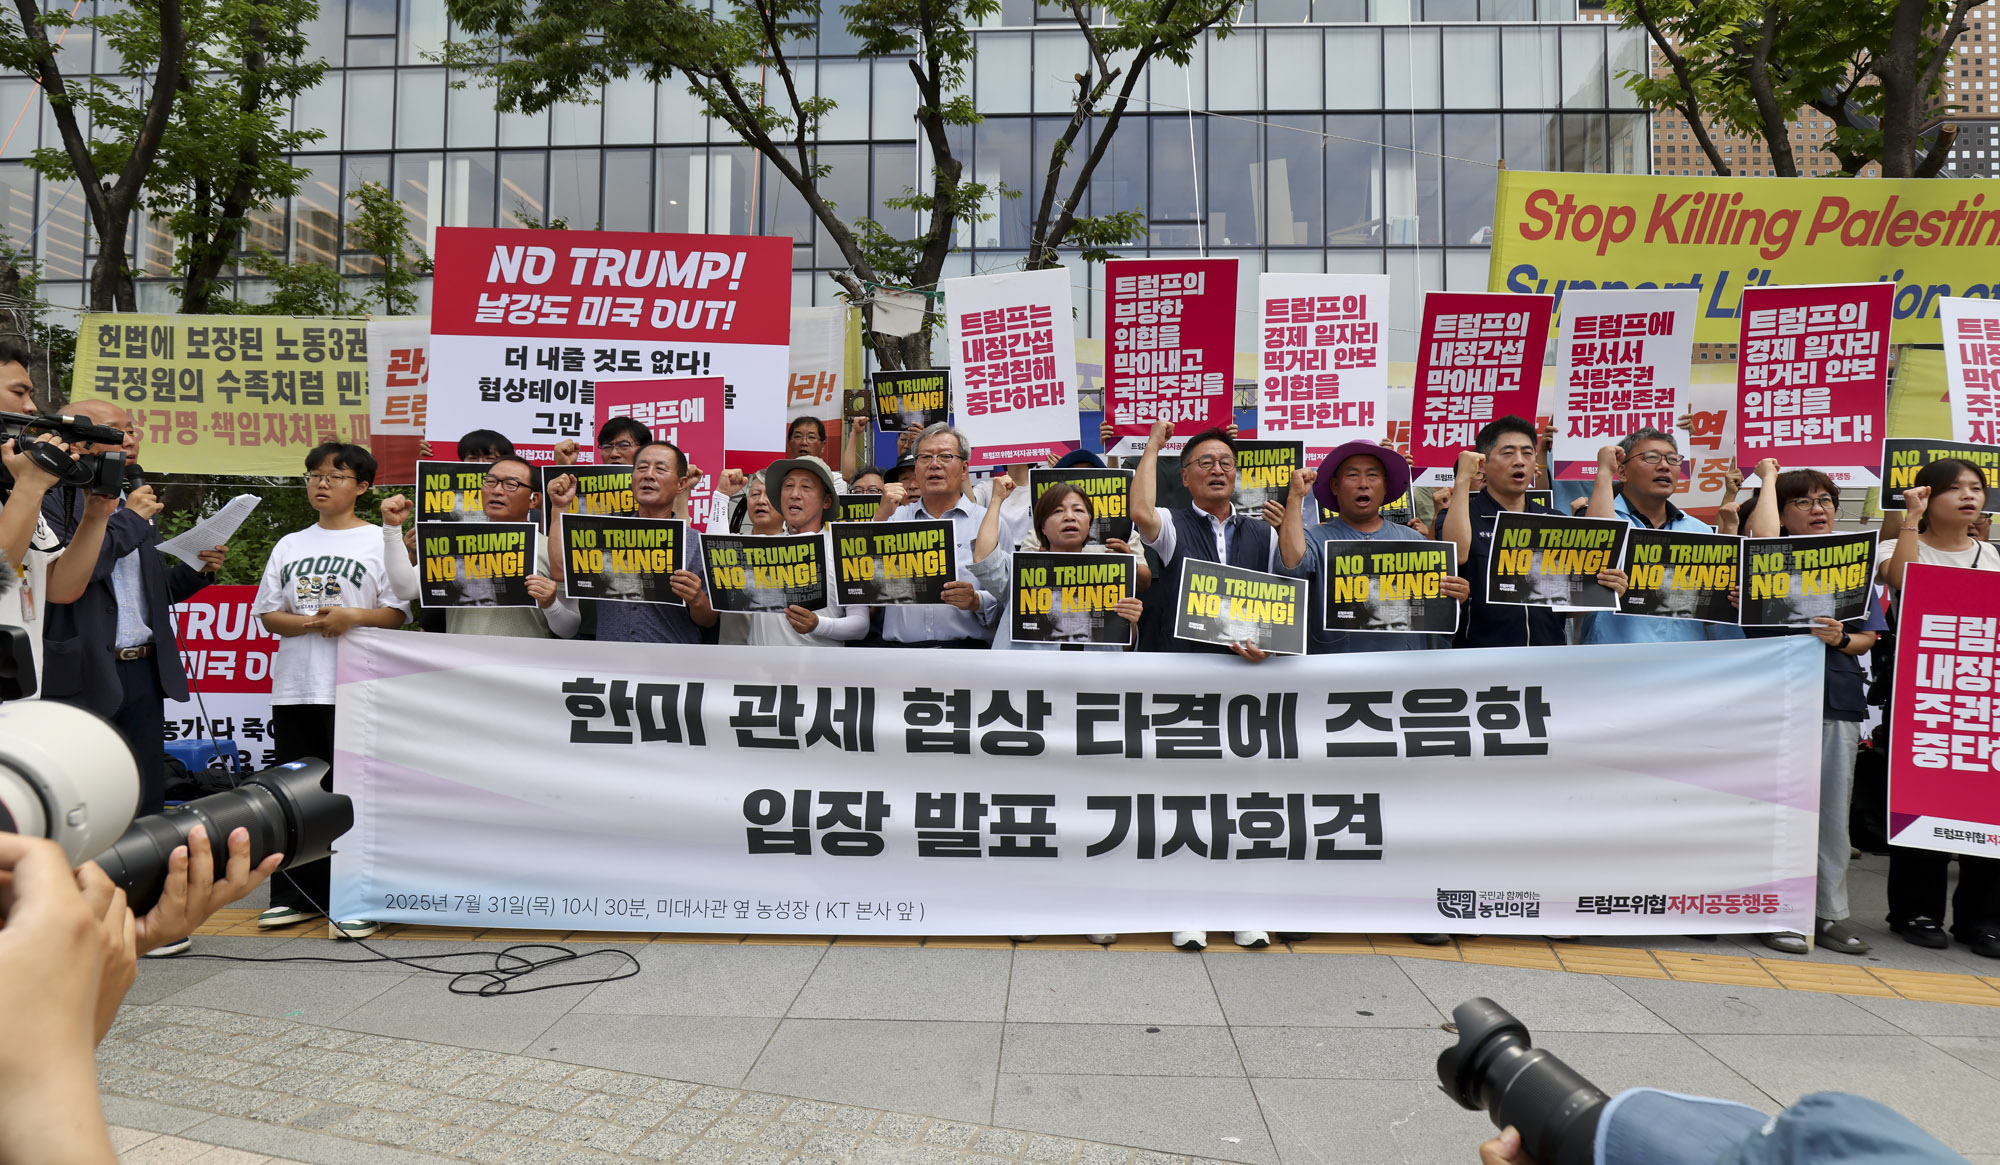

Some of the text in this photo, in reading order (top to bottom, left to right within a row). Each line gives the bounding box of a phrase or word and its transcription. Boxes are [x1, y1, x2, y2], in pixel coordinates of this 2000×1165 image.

[1519, 188, 1637, 256] Stop
[1643, 191, 1802, 260] Killing
[486, 244, 747, 291] NO TRUMP!
[1114, 271, 1206, 300] 트럼프의
[475, 292, 737, 331] 날강도 미국 OUT!
[960, 304, 1052, 337] 트럼프는
[1114, 298, 1184, 326] 부당한
[1265, 294, 1367, 325] 트럼프의
[1747, 301, 1869, 337] 트럼프의
[1114, 324, 1181, 351] 위협을
[1264, 322, 1378, 349] 경제 일자리
[1432, 311, 1531, 339] 트럼프의
[1572, 310, 1675, 339] 트럼프에
[98, 324, 174, 360] 헌법에
[186, 326, 263, 362] 보장된
[962, 329, 1054, 364] 내정간섭
[1429, 339, 1526, 368] 내정간섭
[1571, 339, 1644, 367] 맞서서
[1746, 331, 1880, 363] 경제 일자리
[505, 345, 711, 376] 더 내줄 것도 없다!
[964, 355, 1057, 390] 주권침해
[1114, 349, 1203, 376] 막아내고
[1264, 346, 1377, 373] 먹거리 안보
[1744, 357, 1876, 388] 먹거리 안보
[94, 365, 204, 404] 국정원의
[216, 369, 325, 406] 수족처럼
[877, 376, 944, 396] NO TRUMP!
[1114, 372, 1225, 402] 국민주권을
[1264, 373, 1340, 402] 위협을
[1426, 367, 1522, 394] 막아내고
[1569, 366, 1654, 390] 식량주권
[879, 390, 944, 415] NO KING!
[966, 381, 1066, 417] 중단하라!
[1113, 399, 1209, 426] 실현하자!
[1424, 394, 1495, 421] 주권을
[1568, 387, 1676, 412] 국민생존권
[1744, 387, 1832, 419] 위협을
[532, 412, 584, 437] 그만
[1264, 401, 1375, 432] 규탄한다!
[1567, 411, 1675, 438] 지켜내자!
[1743, 414, 1873, 449] 규탄한다!
[1237, 447, 1296, 467] TRUMP!
[1891, 450, 1920, 467] NO
[425, 474, 451, 490] NO
[425, 491, 455, 514] NO
[425, 531, 525, 556] NO TRUMP!
[571, 528, 674, 548] NO TRUMP!
[840, 529, 945, 556] NO TRUMP!
[1501, 528, 1616, 549] NO TRUMP!
[426, 551, 525, 583] NO KING!
[572, 548, 673, 574] NO KING!
[711, 542, 815, 566] NO TRUMP!
[842, 550, 947, 582] NO KING!
[1335, 550, 1447, 576] NO TRUMP!
[1497, 549, 1611, 576] NO KING!
[1633, 544, 1738, 565] NO TRUMP!
[1752, 540, 1870, 573] NO TRUMP!
[280, 555, 368, 592] WOODIE
[713, 562, 818, 590] NO KING!
[1020, 562, 1126, 588] NO TRUMP!
[1190, 573, 1295, 602] NO TRUMP!
[1334, 571, 1447, 604] NO KING!
[1629, 565, 1738, 591] NO KING!
[1751, 561, 1869, 600] NO KING!
[1019, 584, 1126, 616] NO KING!
[1187, 591, 1295, 626] NO KING!
[211, 716, 236, 740] 다
[561, 677, 1552, 760] 한미 관세 협상 타결에 즈음한
[742, 788, 1384, 861] 입장 발표 기자회견
[384, 893, 448, 913] 2025년
[453, 894, 481, 914] 7월
[487, 895, 555, 917] 31일(목)
[562, 896, 598, 916] 10시
[604, 898, 650, 920] 30분,
[656, 898, 728, 919] 미대사관
[733, 899, 750, 919] 옆
[756, 900, 810, 920] 농성장
[826, 902, 850, 919] KT
[855, 901, 891, 921] 본사
[897, 900, 915, 921] 앞
[1478, 890, 1540, 901] 국민과 함께하는
[1575, 893, 1781, 916] 트럼프위협저지공동행동
[1478, 901, 1540, 919] 농민의길
